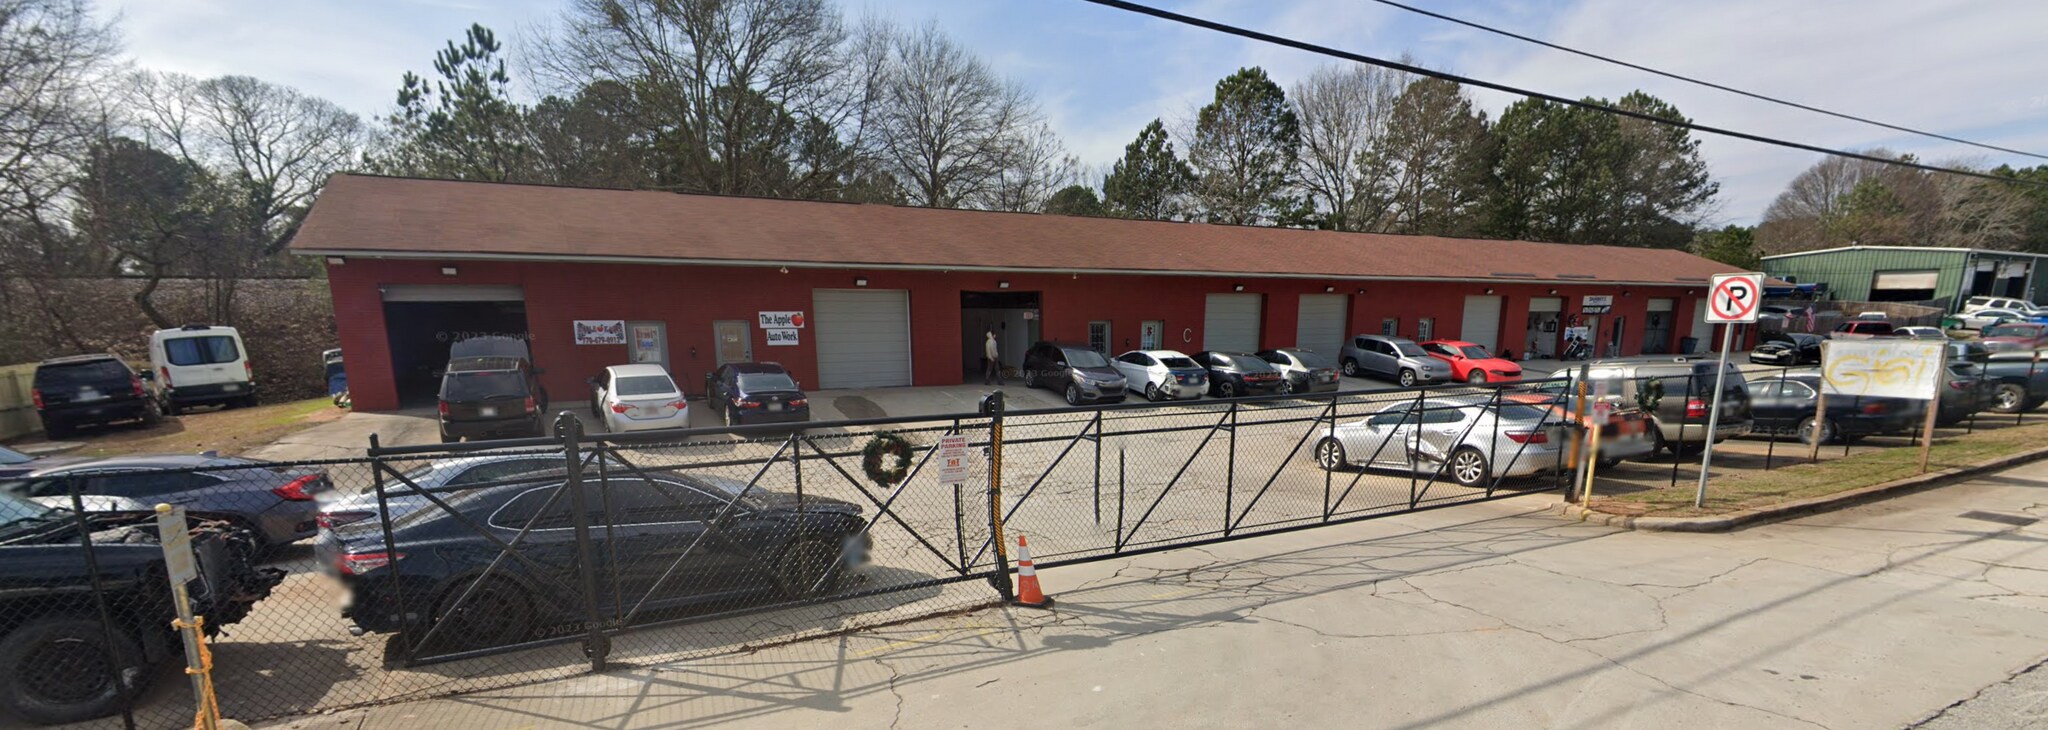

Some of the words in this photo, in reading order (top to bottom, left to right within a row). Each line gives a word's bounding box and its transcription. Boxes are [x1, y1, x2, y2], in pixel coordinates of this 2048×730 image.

[1726, 286, 1747, 311] P
[760, 314, 772, 324] The
[773, 314, 791, 326] Apple
[768, 331, 781, 341] Auto
[781, 331, 797, 341] Work
[1183, 328, 1192, 343] C
